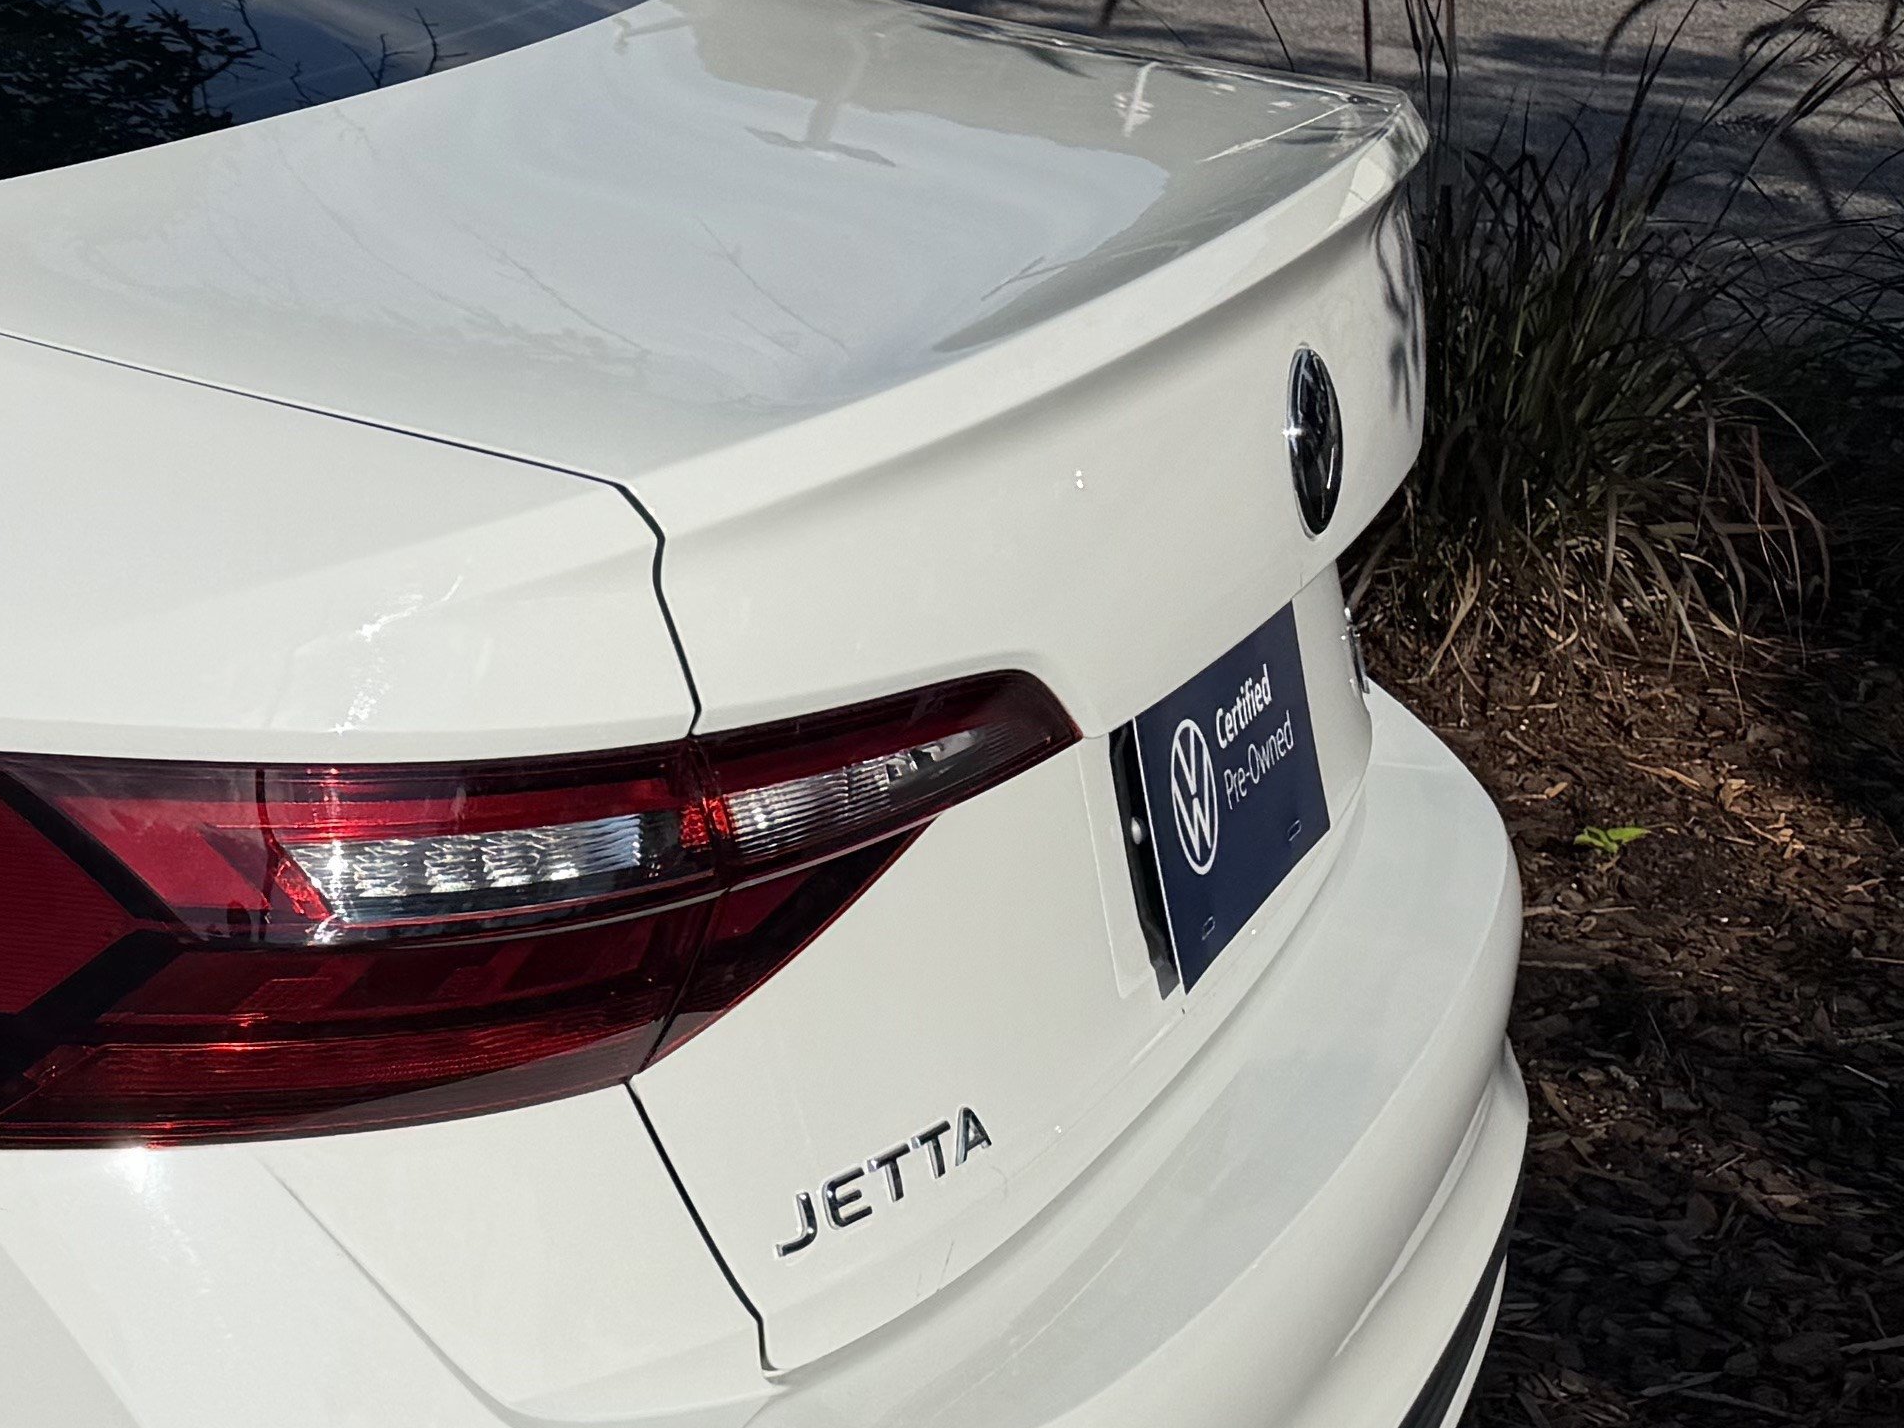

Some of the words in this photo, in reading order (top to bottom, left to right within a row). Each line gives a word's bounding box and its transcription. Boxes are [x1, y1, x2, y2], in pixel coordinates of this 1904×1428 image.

[1215, 664, 1272, 750] Certified
[1223, 710, 1295, 811] Pre-Owned
[775, 1105, 993, 1258] JETTA
